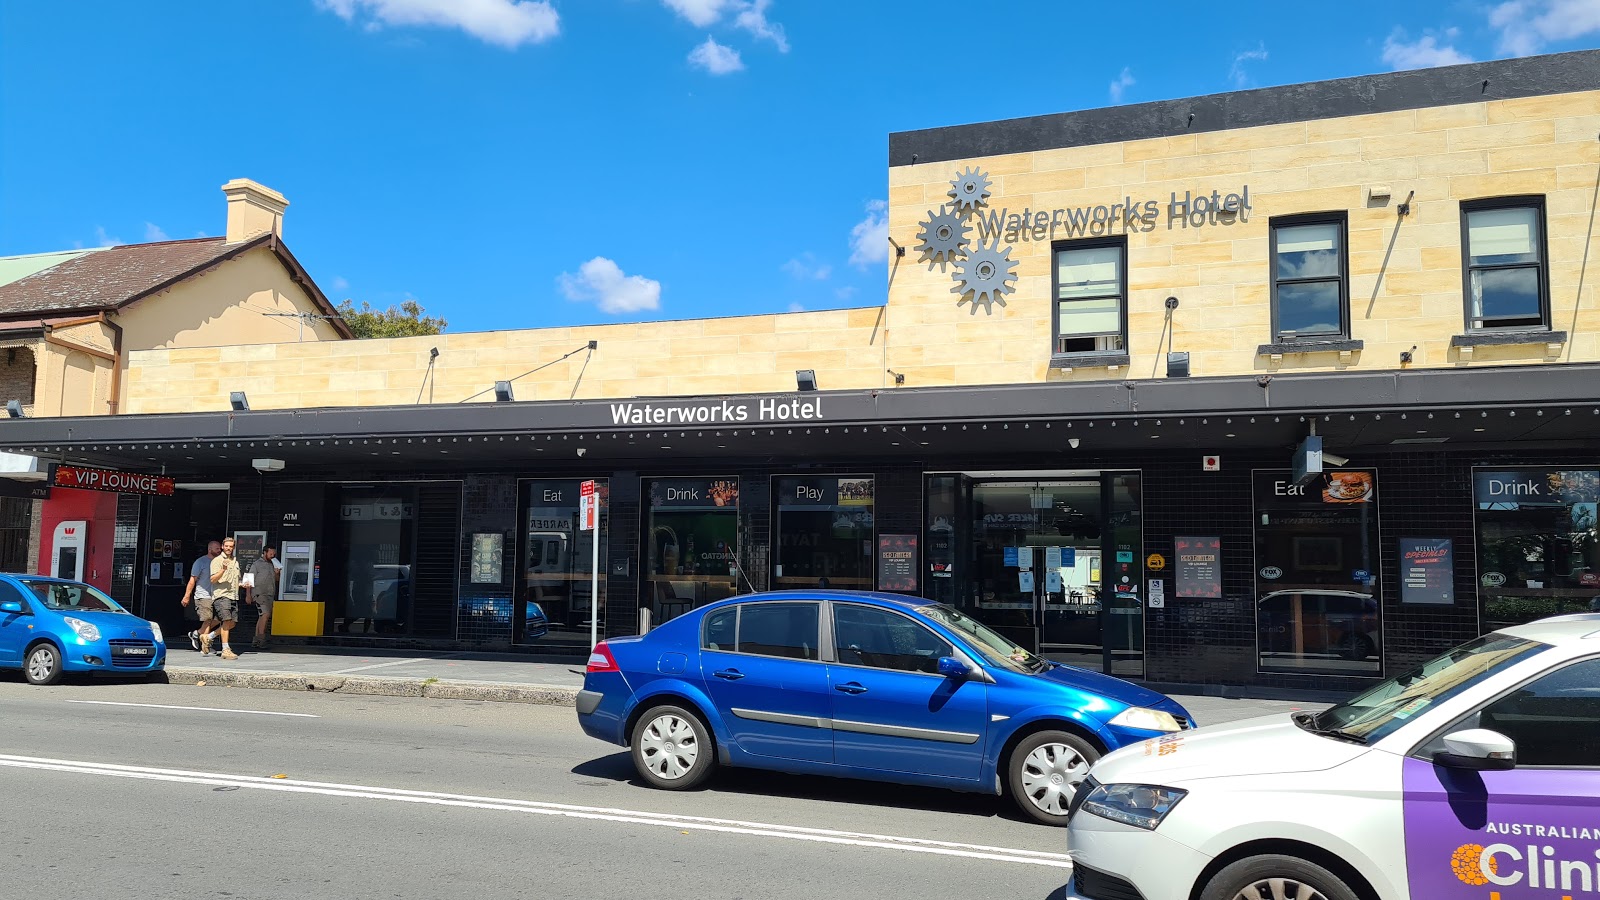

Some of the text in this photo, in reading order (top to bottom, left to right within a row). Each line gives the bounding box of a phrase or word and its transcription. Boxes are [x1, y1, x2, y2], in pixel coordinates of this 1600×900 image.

[981, 185, 1252, 234] Waterworks Hotel
[610, 397, 823, 424] Waterworks Hotel
[75, 470, 158, 491] VIP LOUNGE
[1274, 480, 1305, 496] Eat
[1489, 479, 1540, 495] Drink
[31, 488, 47, 496] ATM
[543, 489, 562, 502] Eat
[667, 488, 699, 500] Drink
[796, 486, 824, 501] Play
[283, 513, 297, 521] ATM
[1404, 549, 1448, 559] SPECIALS!
